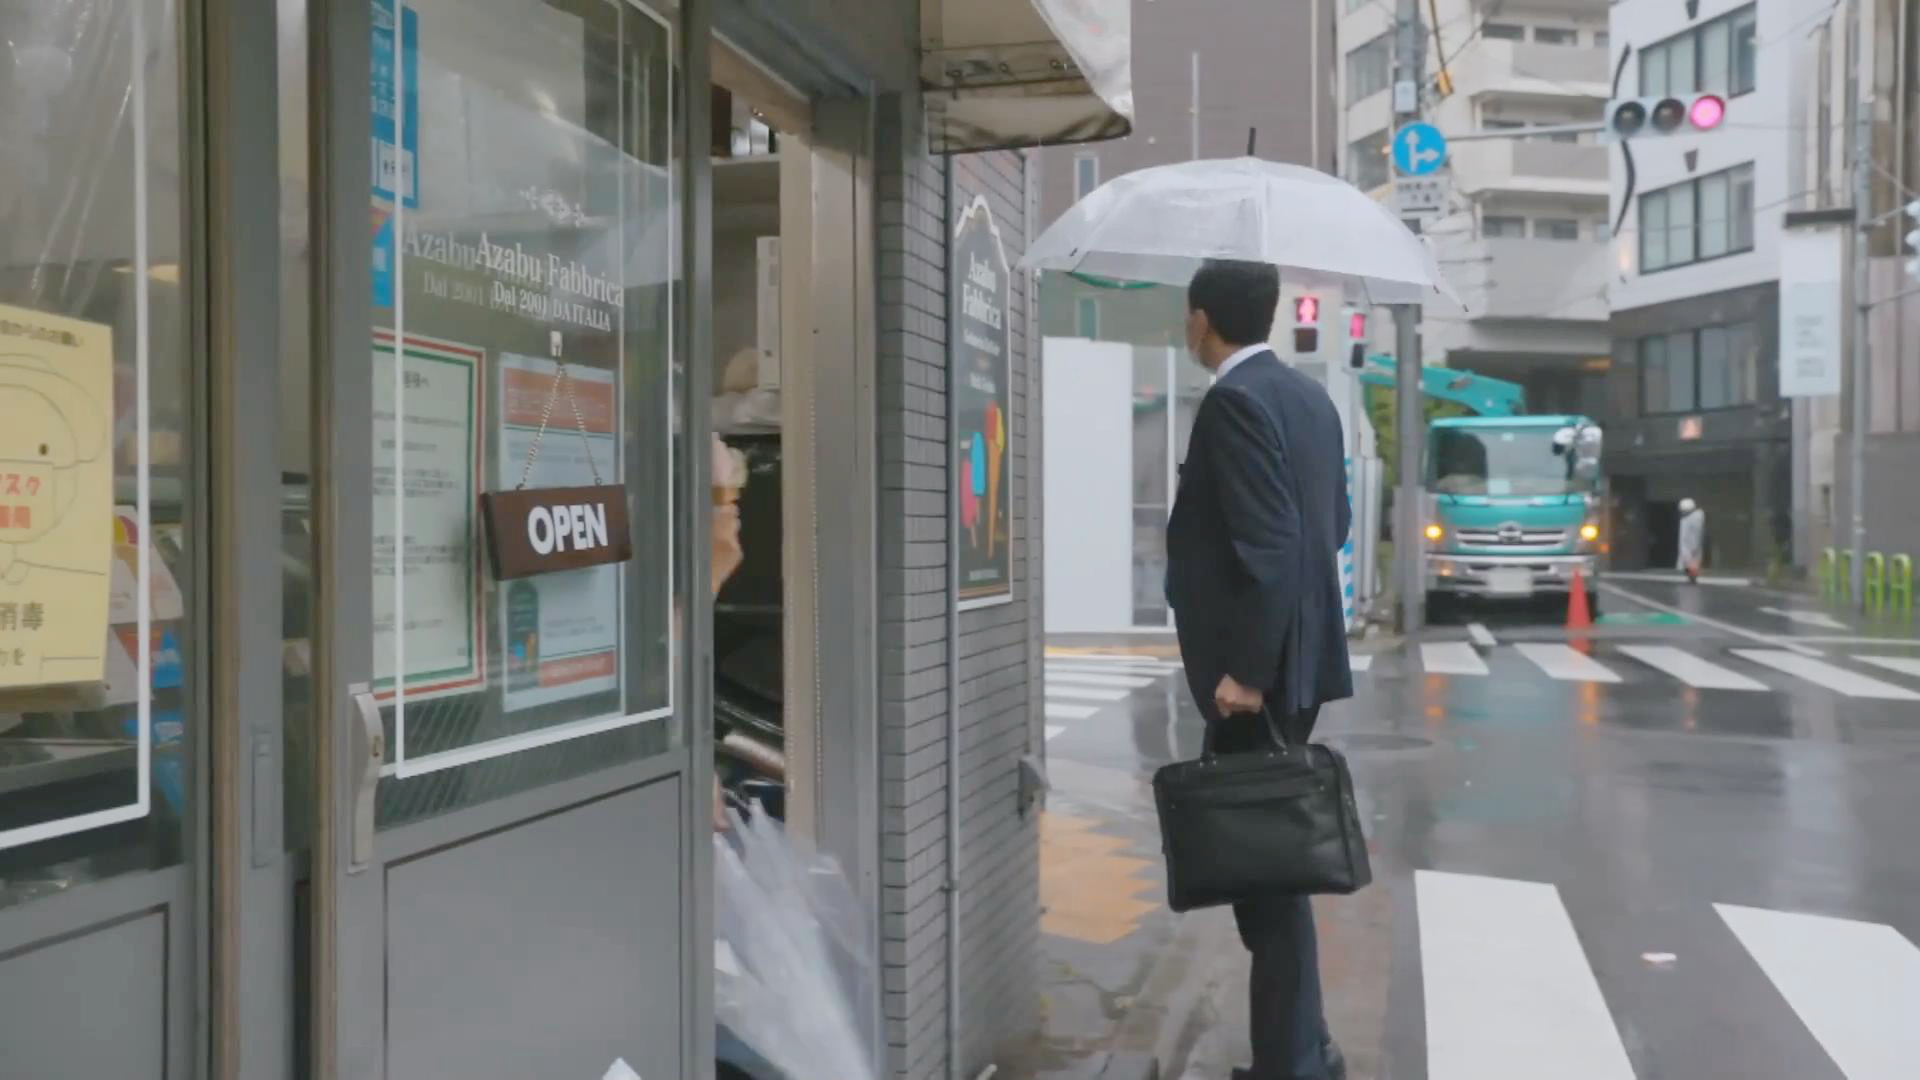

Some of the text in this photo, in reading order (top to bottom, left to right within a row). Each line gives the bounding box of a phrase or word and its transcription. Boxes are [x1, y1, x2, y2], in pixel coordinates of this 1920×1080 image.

[475, 232, 624, 307] Azabu Fabbrica
[493, 280, 516, 306] Dal
[527, 503, 608, 555] OPEN
